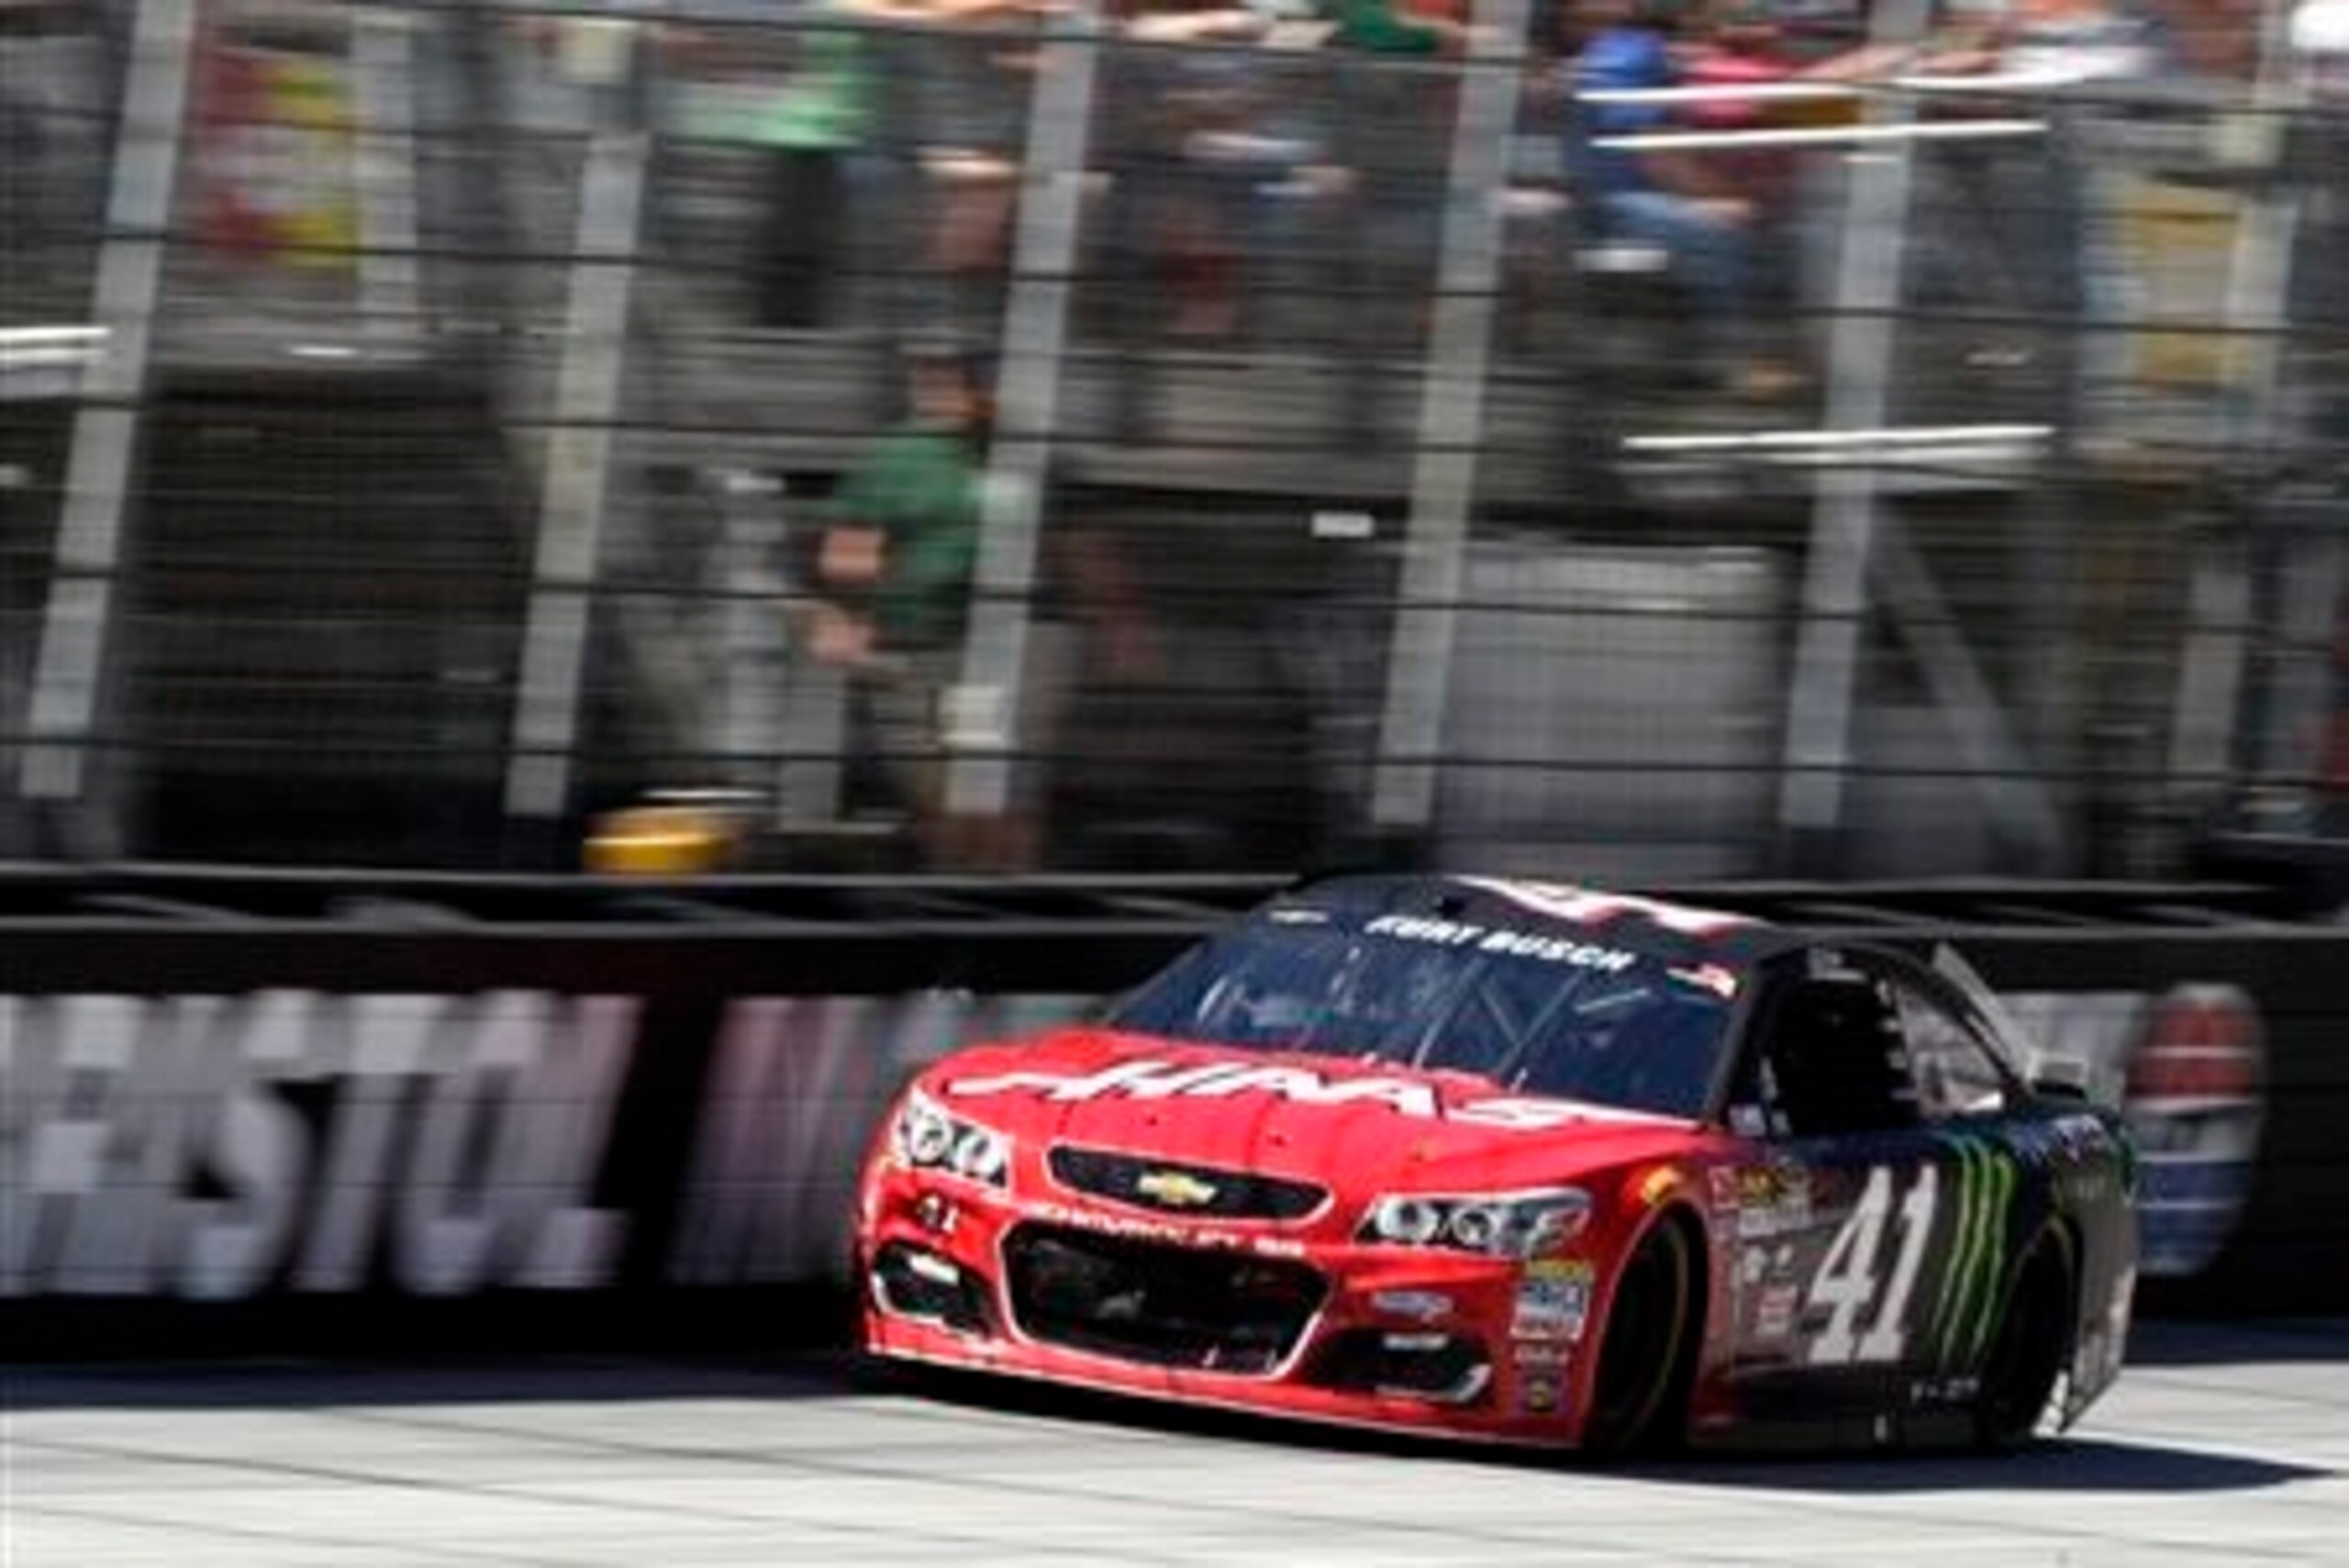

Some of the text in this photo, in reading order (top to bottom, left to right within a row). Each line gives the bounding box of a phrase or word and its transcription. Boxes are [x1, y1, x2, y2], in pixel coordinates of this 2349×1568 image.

[1364, 915, 1485, 945] KURT
[1478, 930, 1636, 972] BUSCH
[948, 1060, 1698, 1129] HAAS
[1809, 1163, 1937, 1364] 41
